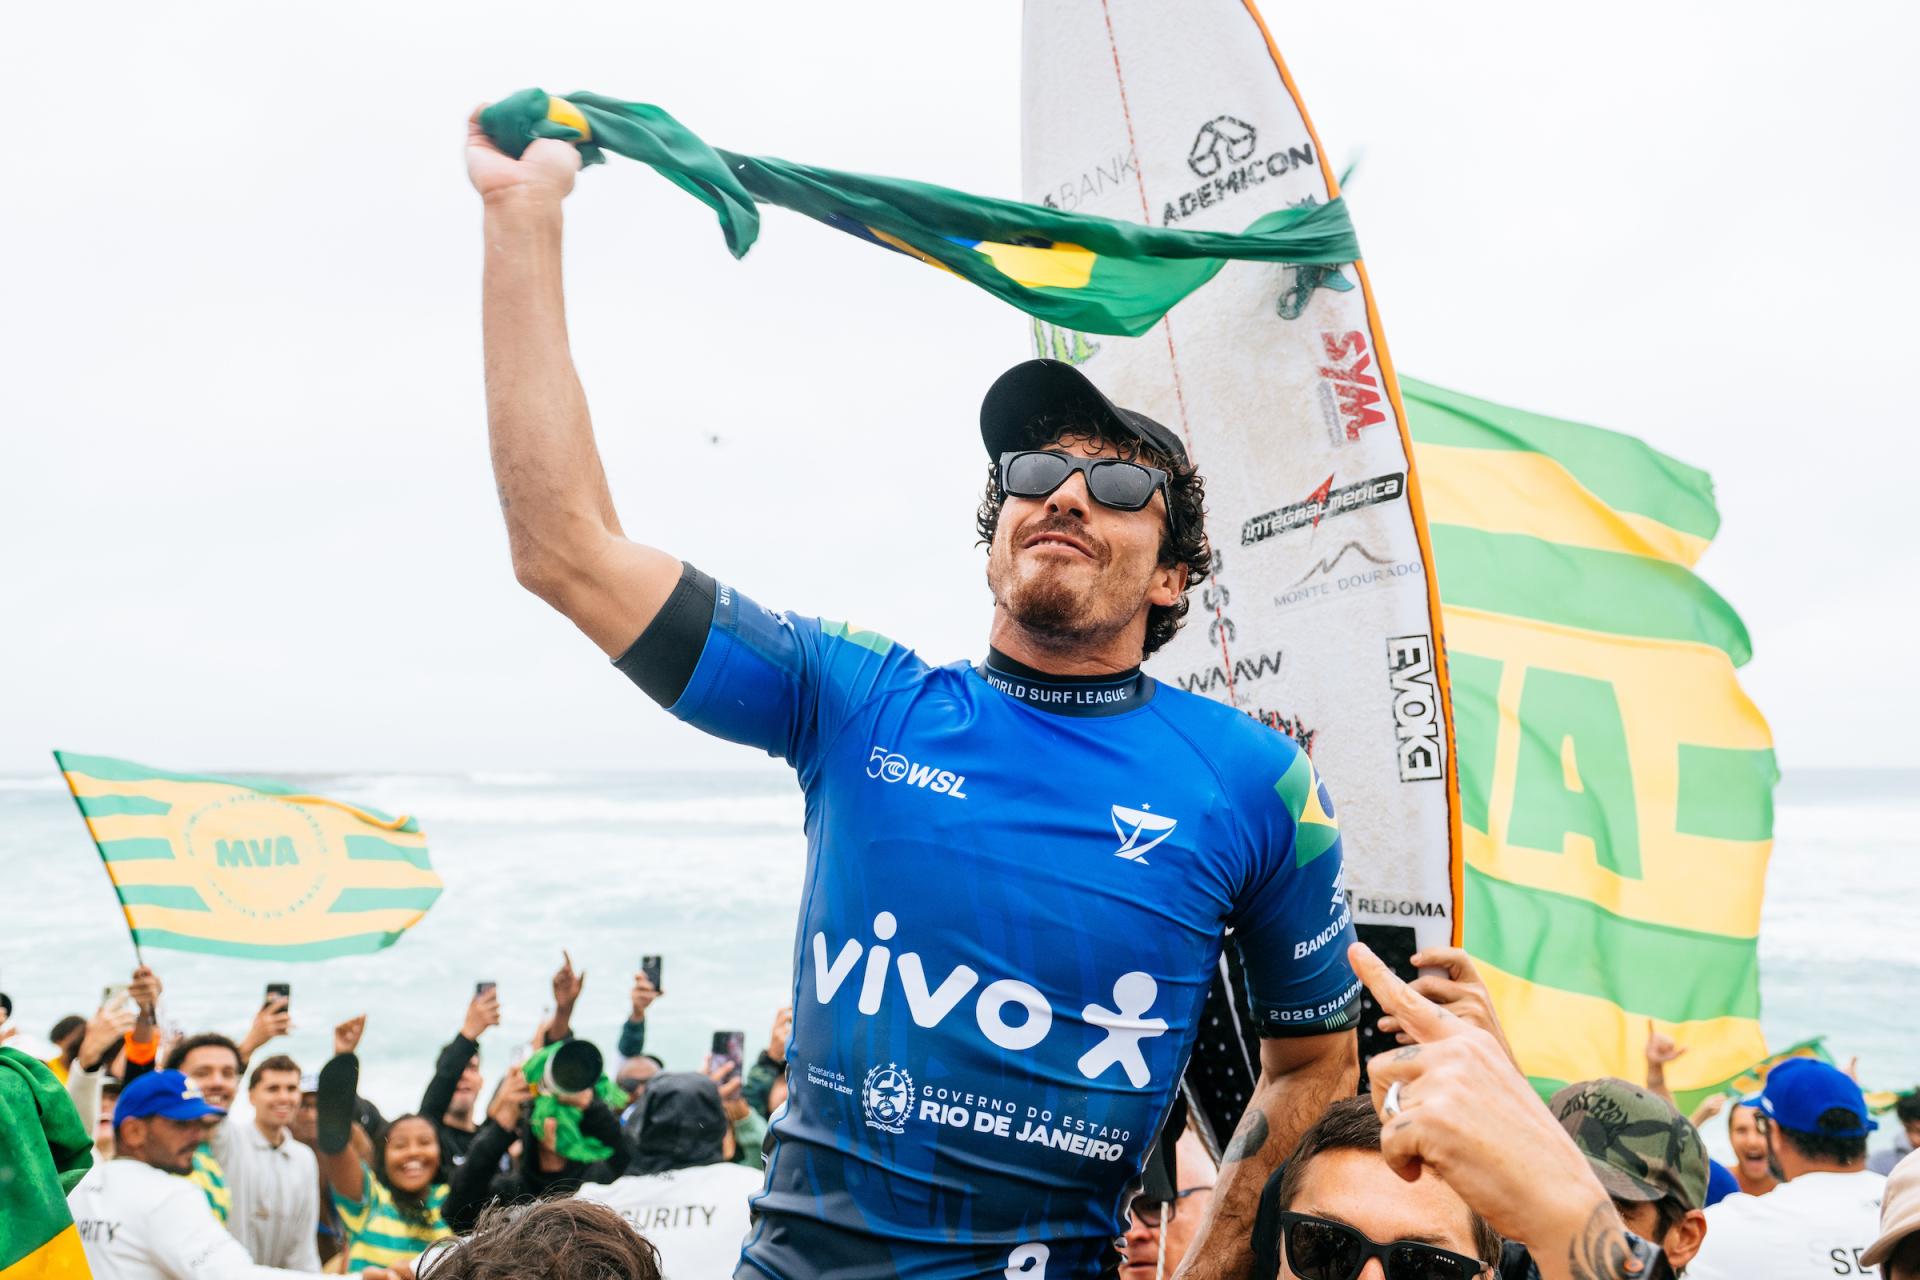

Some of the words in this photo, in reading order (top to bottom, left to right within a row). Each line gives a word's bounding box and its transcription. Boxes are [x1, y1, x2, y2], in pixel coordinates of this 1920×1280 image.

[1060, 146, 1136, 212] BANK
[1163, 143, 1314, 227] ADEMICON
[1274, 582, 1331, 608] MONTE
[1338, 561, 1422, 590] DOURADO
[986, 674, 1026, 698] WORLD
[1029, 688, 1073, 704] SURF
[1076, 687, 1128, 704] LEAGUE
[1386, 634, 1443, 783] EVOKE
[906, 762, 967, 799] WSL
[215, 836, 300, 868] MVA
[1358, 898, 1446, 918] REDOMA
[1294, 921, 1339, 960] BANCO
[812, 911, 1053, 1051] vivo
[1270, 1008, 1315, 1021] 2026
[1318, 979, 1362, 1016] CHAMPI
[807, 1073, 829, 1089] Esporte
[834, 1082, 854, 1096] Lazer
[808, 1063, 835, 1078] Secretaria
[835, 1071, 846, 1082] de
[919, 1099, 970, 1128] RIO
[973, 1111, 1012, 1138] DE
[1016, 1122, 1124, 1162] JANEIRO
[923, 1085, 1017, 1114] GOVERNO
[1027, 1106, 1052, 1121] DO
[1062, 1116, 1130, 1141] ESTADO
